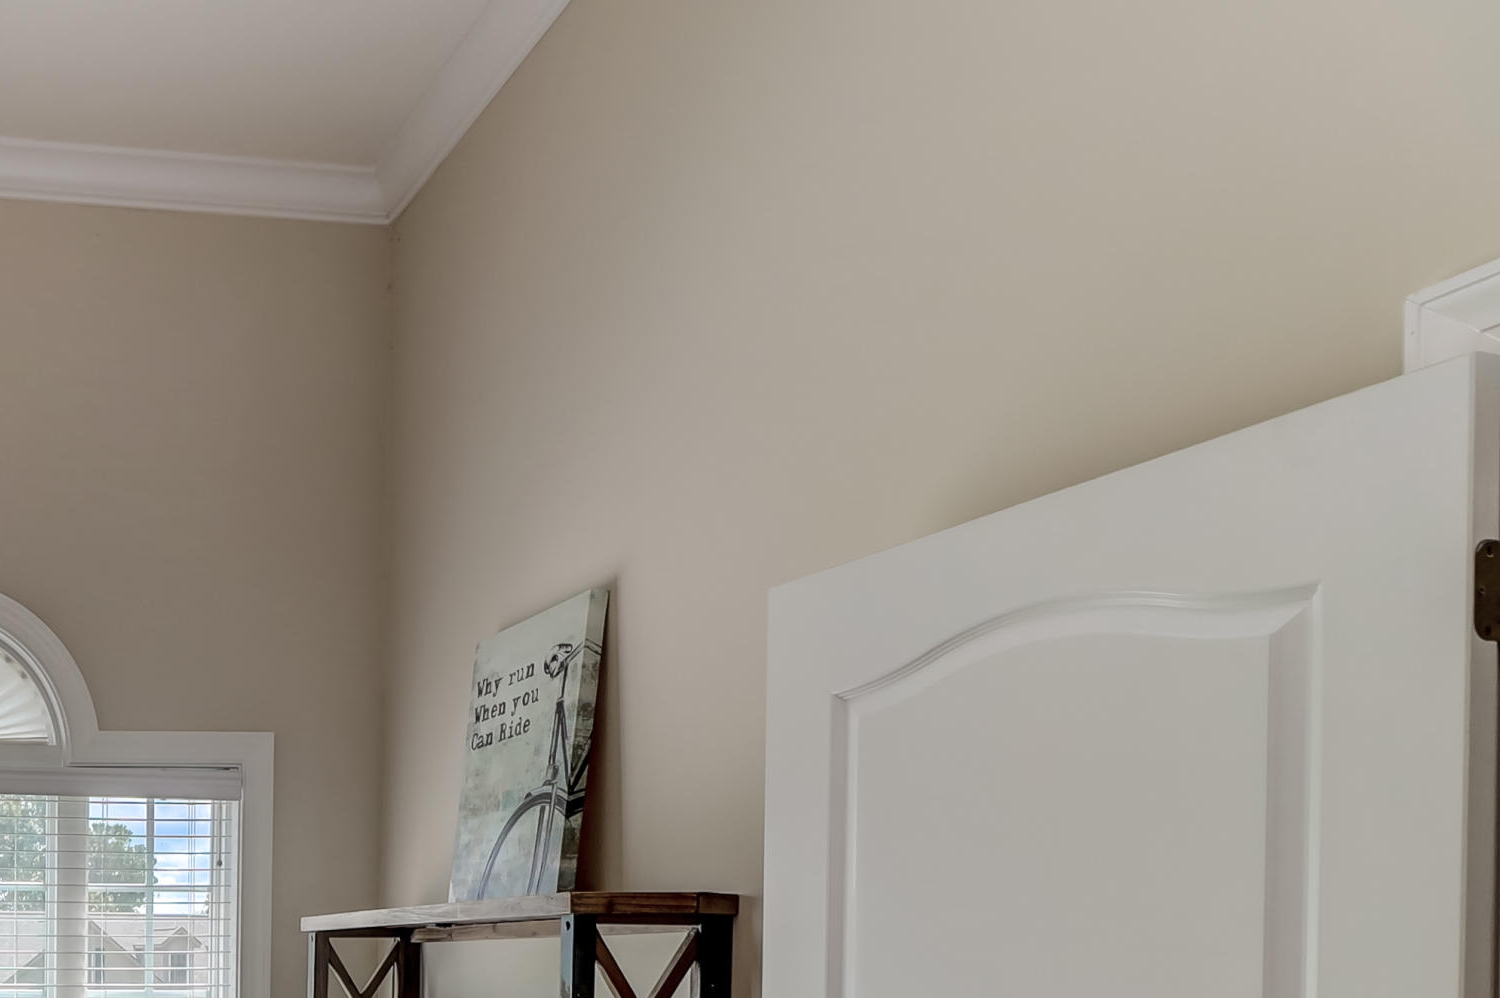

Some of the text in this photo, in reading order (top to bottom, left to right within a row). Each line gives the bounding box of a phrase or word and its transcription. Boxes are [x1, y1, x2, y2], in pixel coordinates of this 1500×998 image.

[477, 662, 535, 698] Why run
[475, 688, 539, 724] When you
[471, 716, 531, 751] Can Ride
